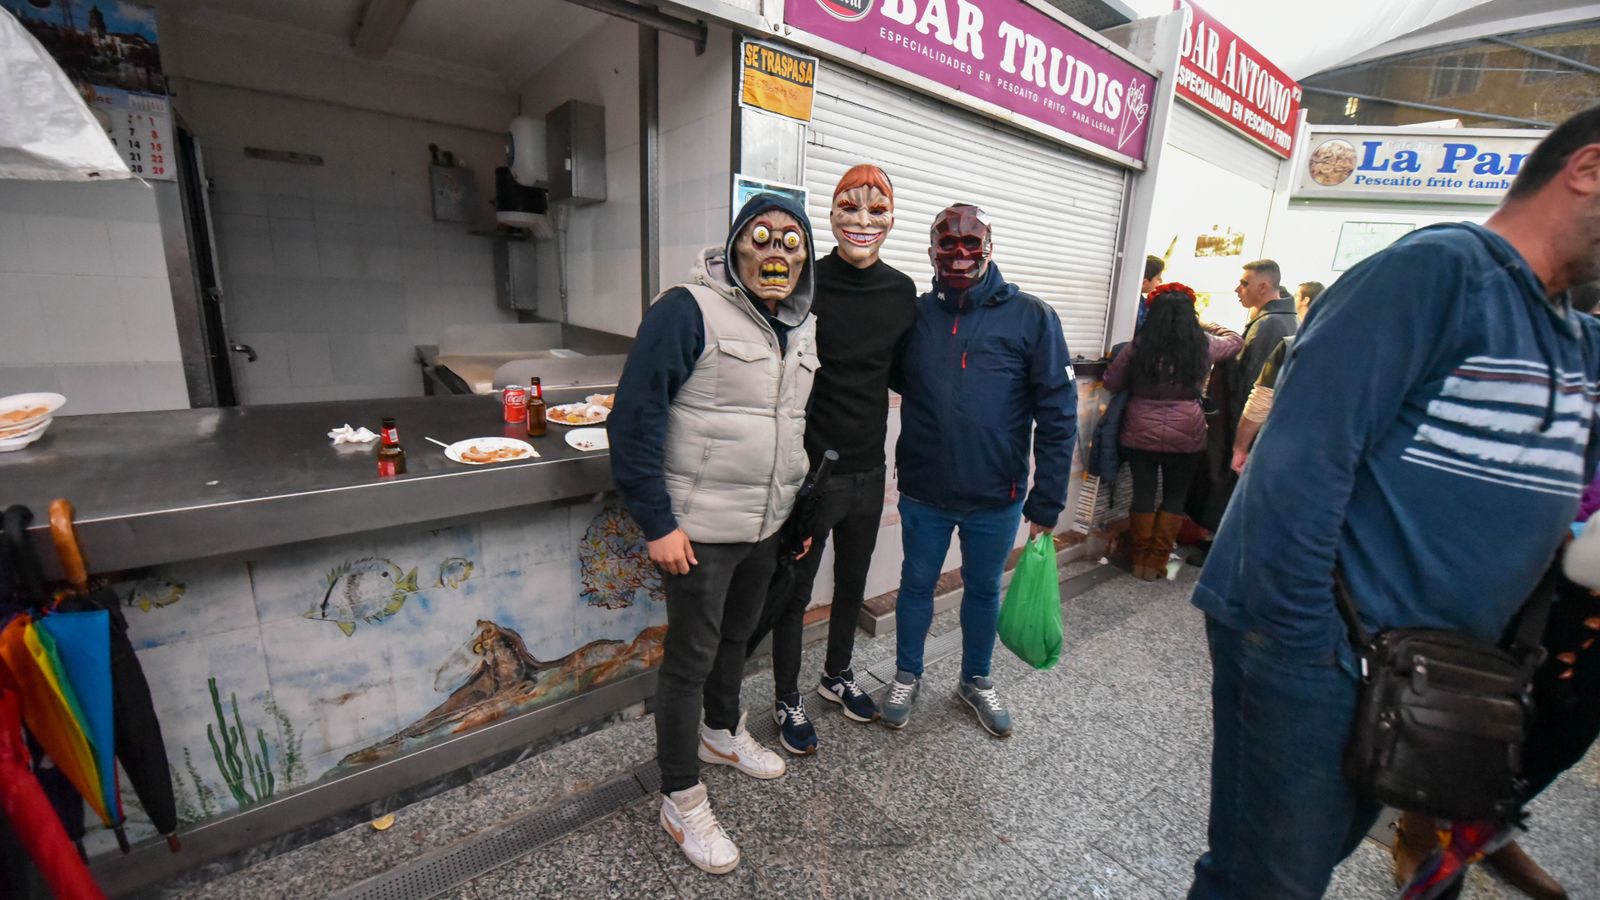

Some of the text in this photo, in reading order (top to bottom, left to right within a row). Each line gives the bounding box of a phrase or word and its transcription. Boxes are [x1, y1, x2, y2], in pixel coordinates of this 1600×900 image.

[745, 43, 813, 84] SE TRASPASA
[880, 27, 972, 75] ESPECIALIDADES
[978, 70, 991, 83] EN
[997, 78, 1039, 103] PESCAITO
[1072, 110, 1090, 125] PARA
[998, 20, 1123, 120] TRUDIS
[1180, 3, 1292, 125] BAR ANTONIO
[1177, 65, 1292, 150] SPECIALIDAD EN PESCAITO FRITO
[129, 152, 141, 161] 21
[131, 164, 143, 174] 28
[1357, 141, 1421, 174] La
[1354, 175, 1509, 190] Pescaito frito tamb
